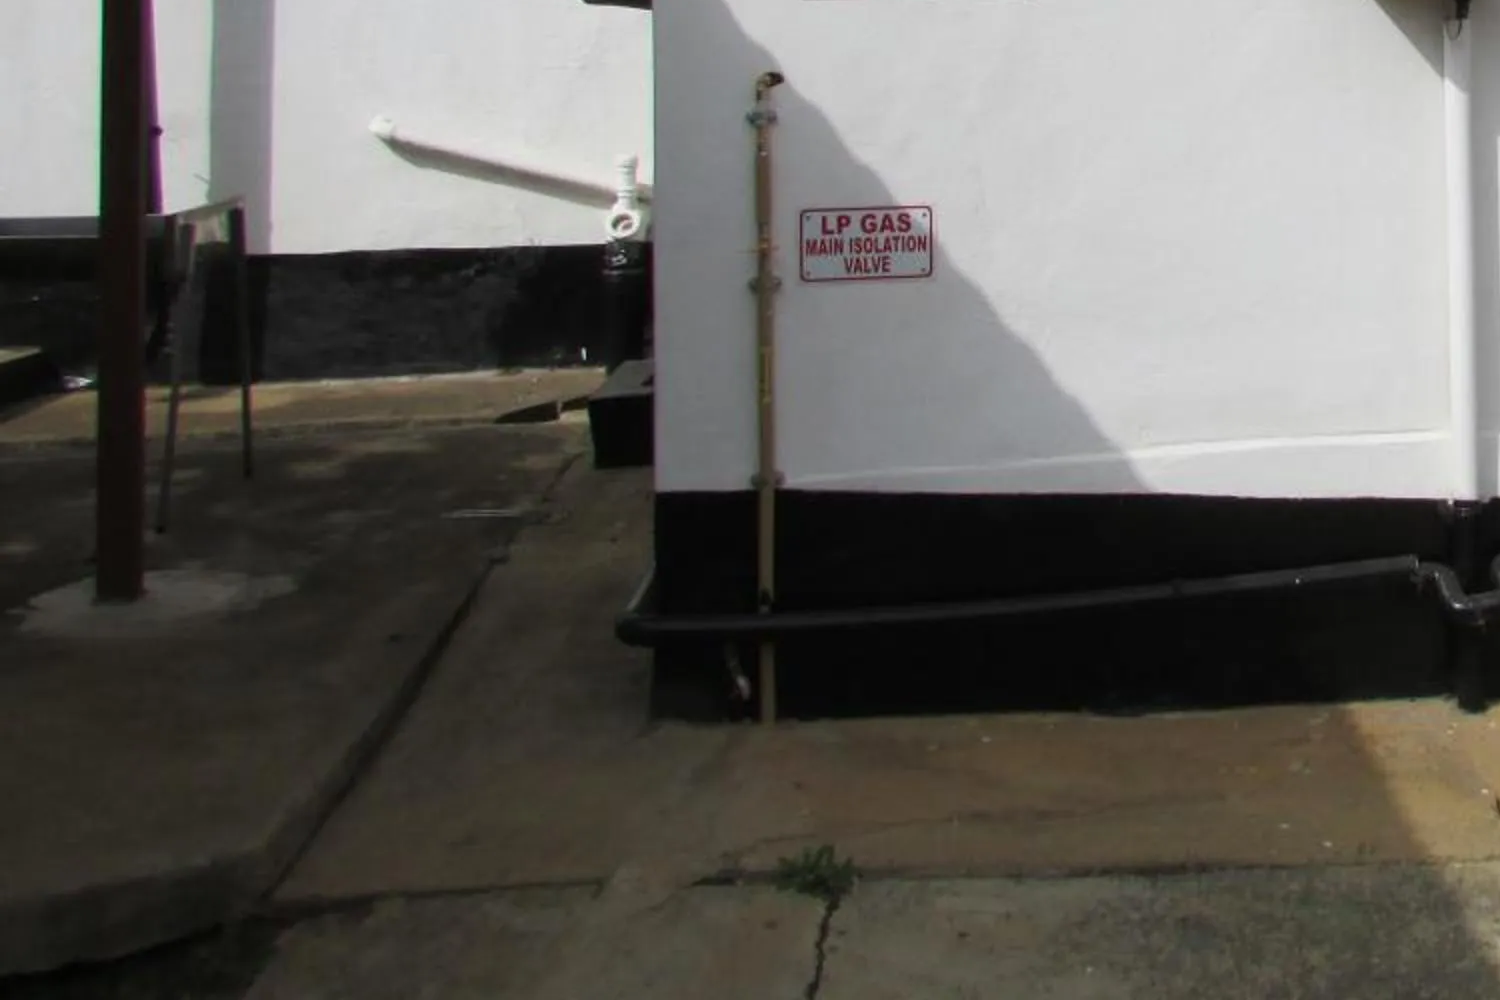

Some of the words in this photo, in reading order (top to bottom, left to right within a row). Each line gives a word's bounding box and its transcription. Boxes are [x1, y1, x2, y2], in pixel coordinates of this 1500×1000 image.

[821, 214, 850, 235] LP
[860, 213, 912, 234] GAS
[806, 237, 843, 256] MAIN
[849, 235, 927, 254] ISOLATION
[843, 256, 891, 273] VALVE
